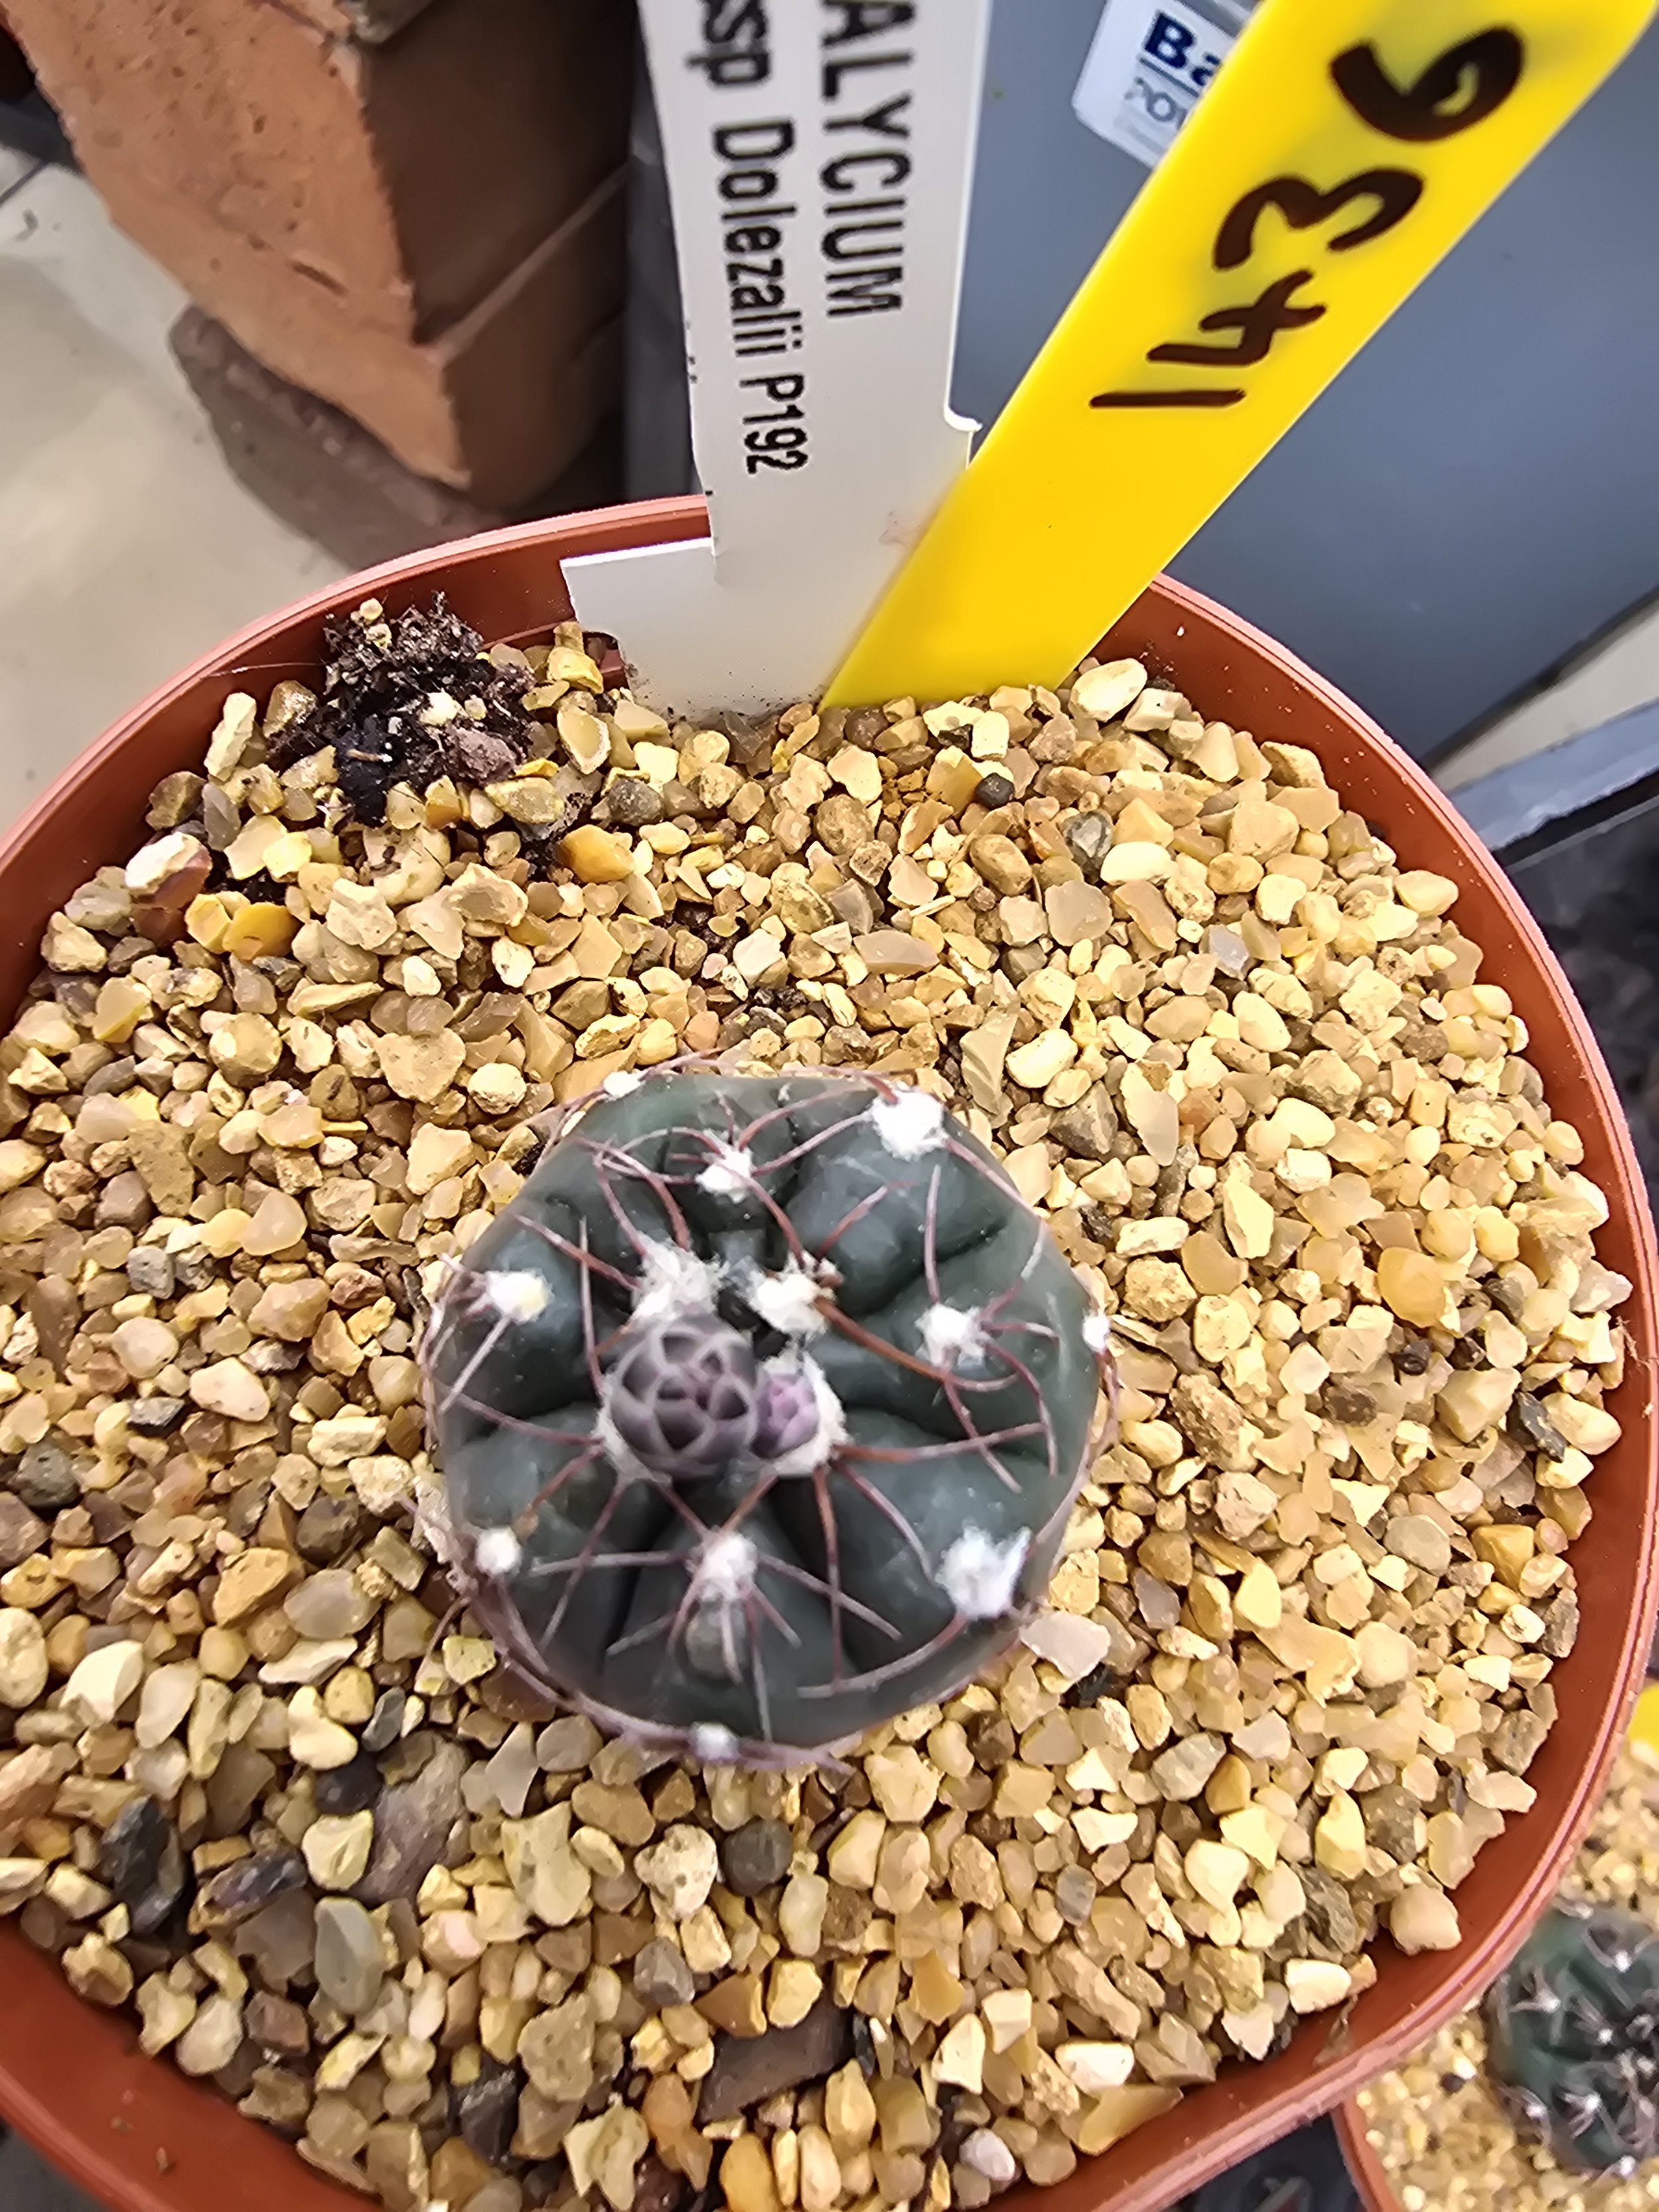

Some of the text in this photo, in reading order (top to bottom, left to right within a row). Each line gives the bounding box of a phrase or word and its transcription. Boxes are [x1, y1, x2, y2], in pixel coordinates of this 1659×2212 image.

[712, 119, 802, 357] Dolezalii
[820, 0, 916, 317] ALYCIUM
[1089, 24, 1526, 409] 1436
[739, 374, 808, 475] P192
